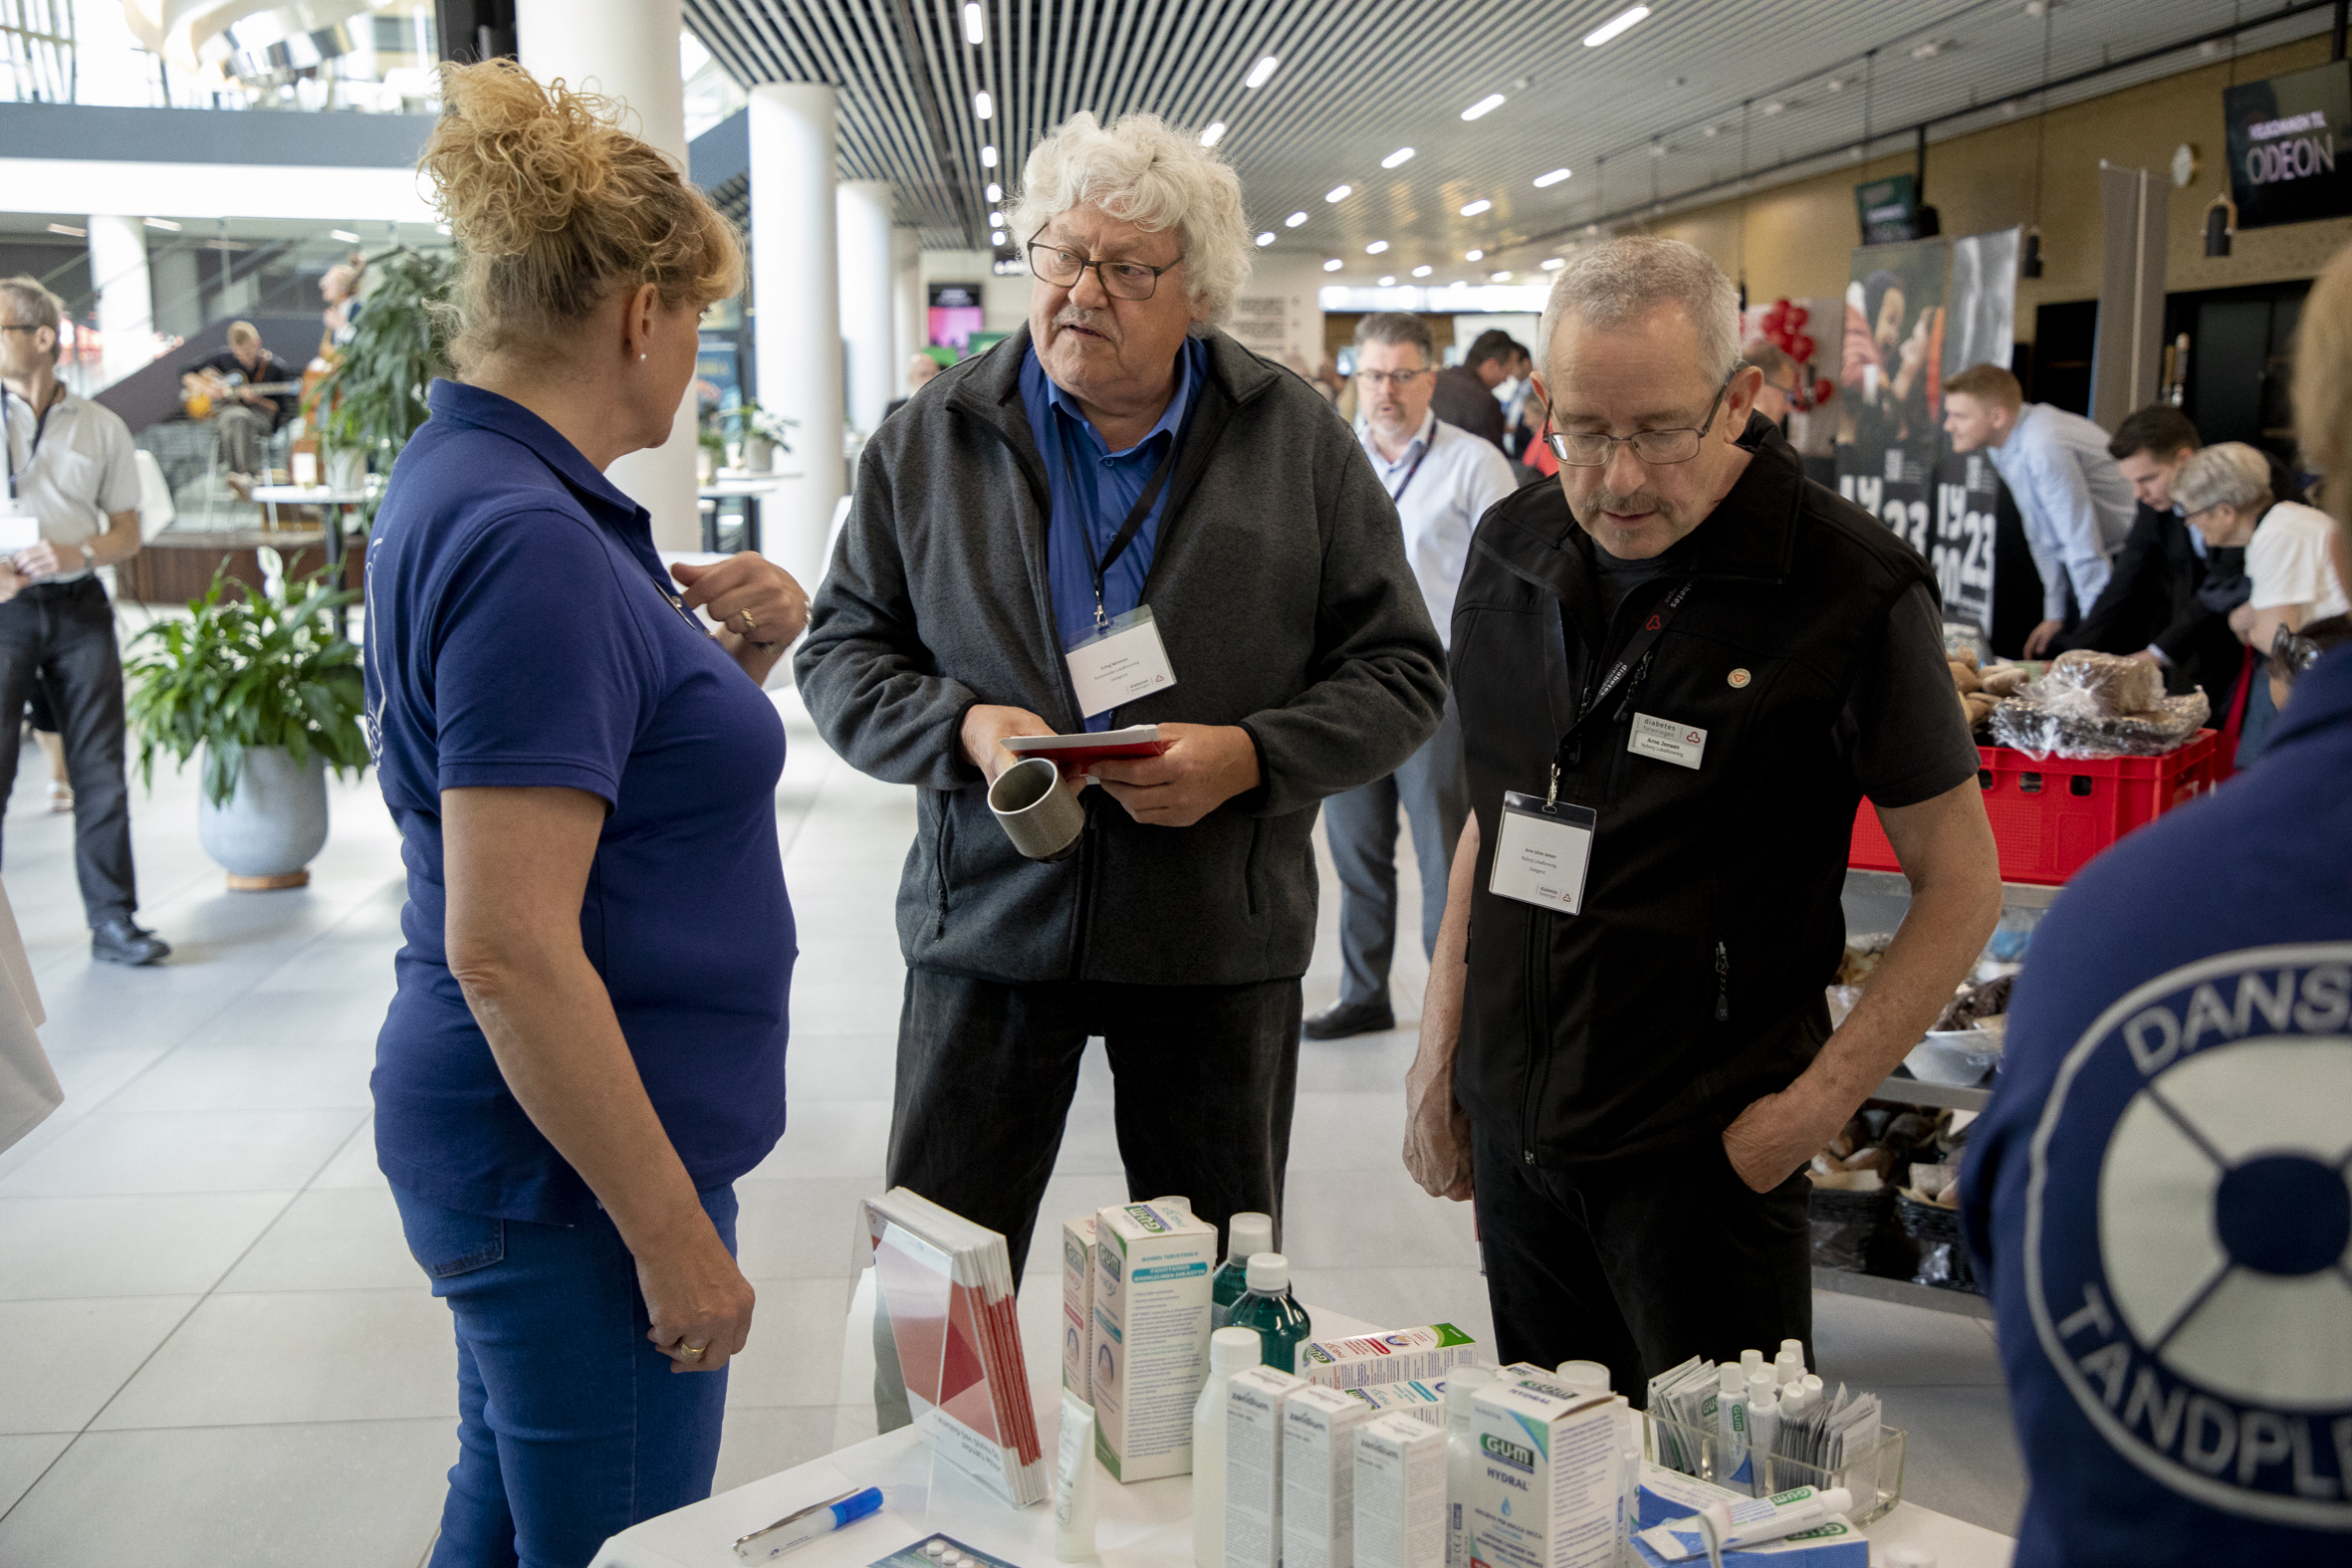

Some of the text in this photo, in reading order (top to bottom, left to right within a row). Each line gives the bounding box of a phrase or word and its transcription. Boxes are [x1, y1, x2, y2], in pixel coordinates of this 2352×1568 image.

[2246, 132, 2336, 185] ODEON
[1937, 483, 1967, 542] 19
[1964, 509, 1998, 589] 23
[1670, 578, 1695, 608] iabetes
[1130, 679, 1148, 688] diabetes
[1600, 664, 1628, 696] diabetes
[1643, 726, 1675, 737] foreningen
[1644, 718, 1676, 731] diabetes
[1656, 747, 1684, 758] Lokalforening
[1660, 741, 1680, 750] Jensen
[1540, 886, 1558, 895] diabetes
[2122, 962, 2352, 1077] DANS
[1232, 1392, 1269, 1412] zendium
[1290, 1412, 1325, 1432] zendium
[1360, 1439, 1398, 1459] zendium
[1486, 1436, 1530, 1464] GUM
[1487, 1466, 1529, 1491] HYDRAL
[1772, 1489, 1808, 1504] GUM
